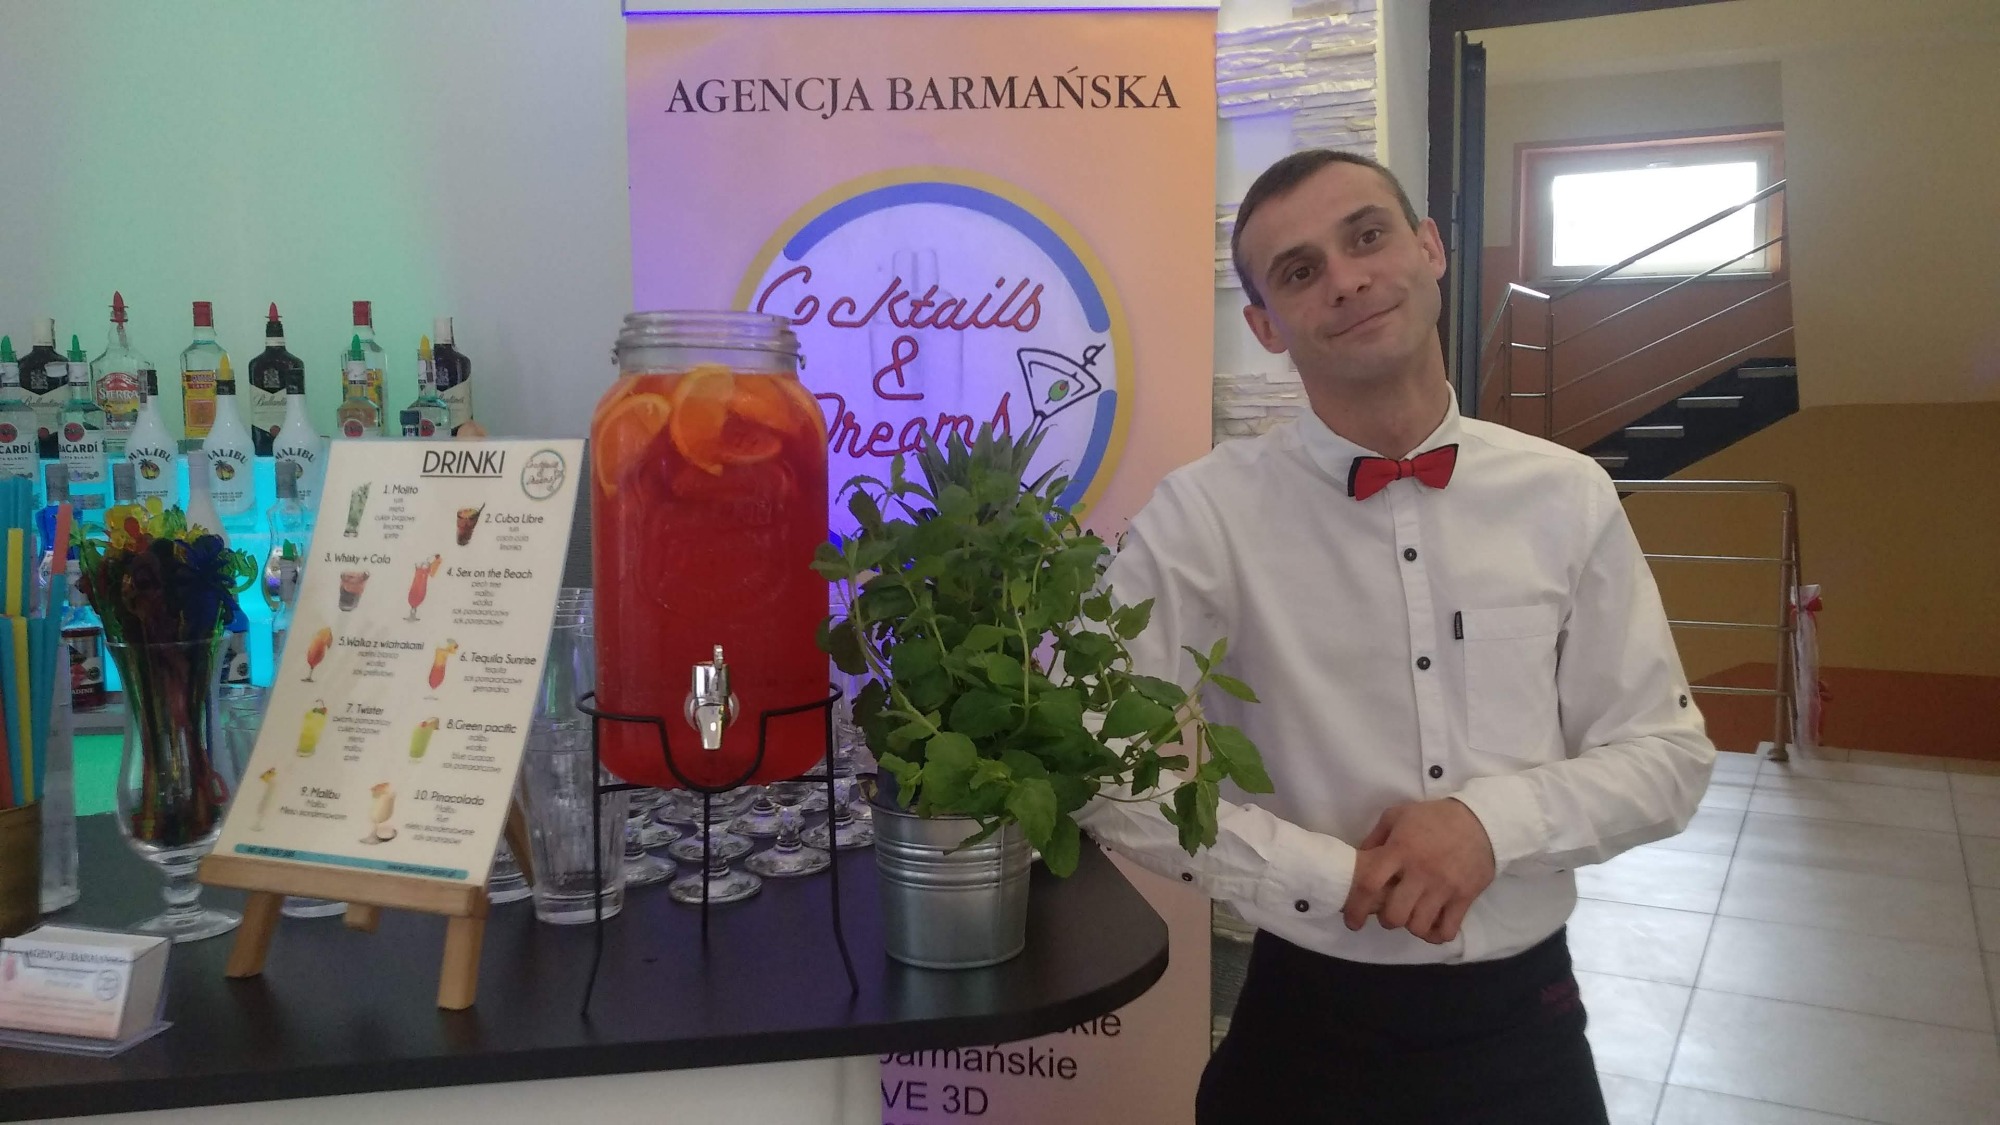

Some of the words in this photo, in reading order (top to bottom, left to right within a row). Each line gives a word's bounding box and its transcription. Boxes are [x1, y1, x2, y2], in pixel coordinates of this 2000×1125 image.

[665, 77, 876, 120] AGENCJA
[887, 66, 1180, 112] BARMAŃSKA
[756, 265, 1043, 332] Cocktails
[872, 335, 924, 400] &
[99, 387, 139, 400] SIERRA
[128, 448, 172, 462] MALIBU
[422, 450, 506, 475] DRINKI
[392, 484, 418, 495] Mojito
[495, 513, 519, 524] Cuba
[521, 513, 544, 524] Libre
[334, 553, 361, 565] Whisky
[370, 554, 391, 564] Cola
[456, 567, 471, 577] Sex
[487, 568, 501, 578] the
[503, 568, 533, 579] Beach
[471, 652, 503, 664] Tequila
[505, 654, 537, 665] Sunrise
[357, 704, 384, 715] Twister
[484, 723, 518, 734] pacific
[311, 787, 341, 800] Malibu
[942, 1084, 988, 1116] 3D
